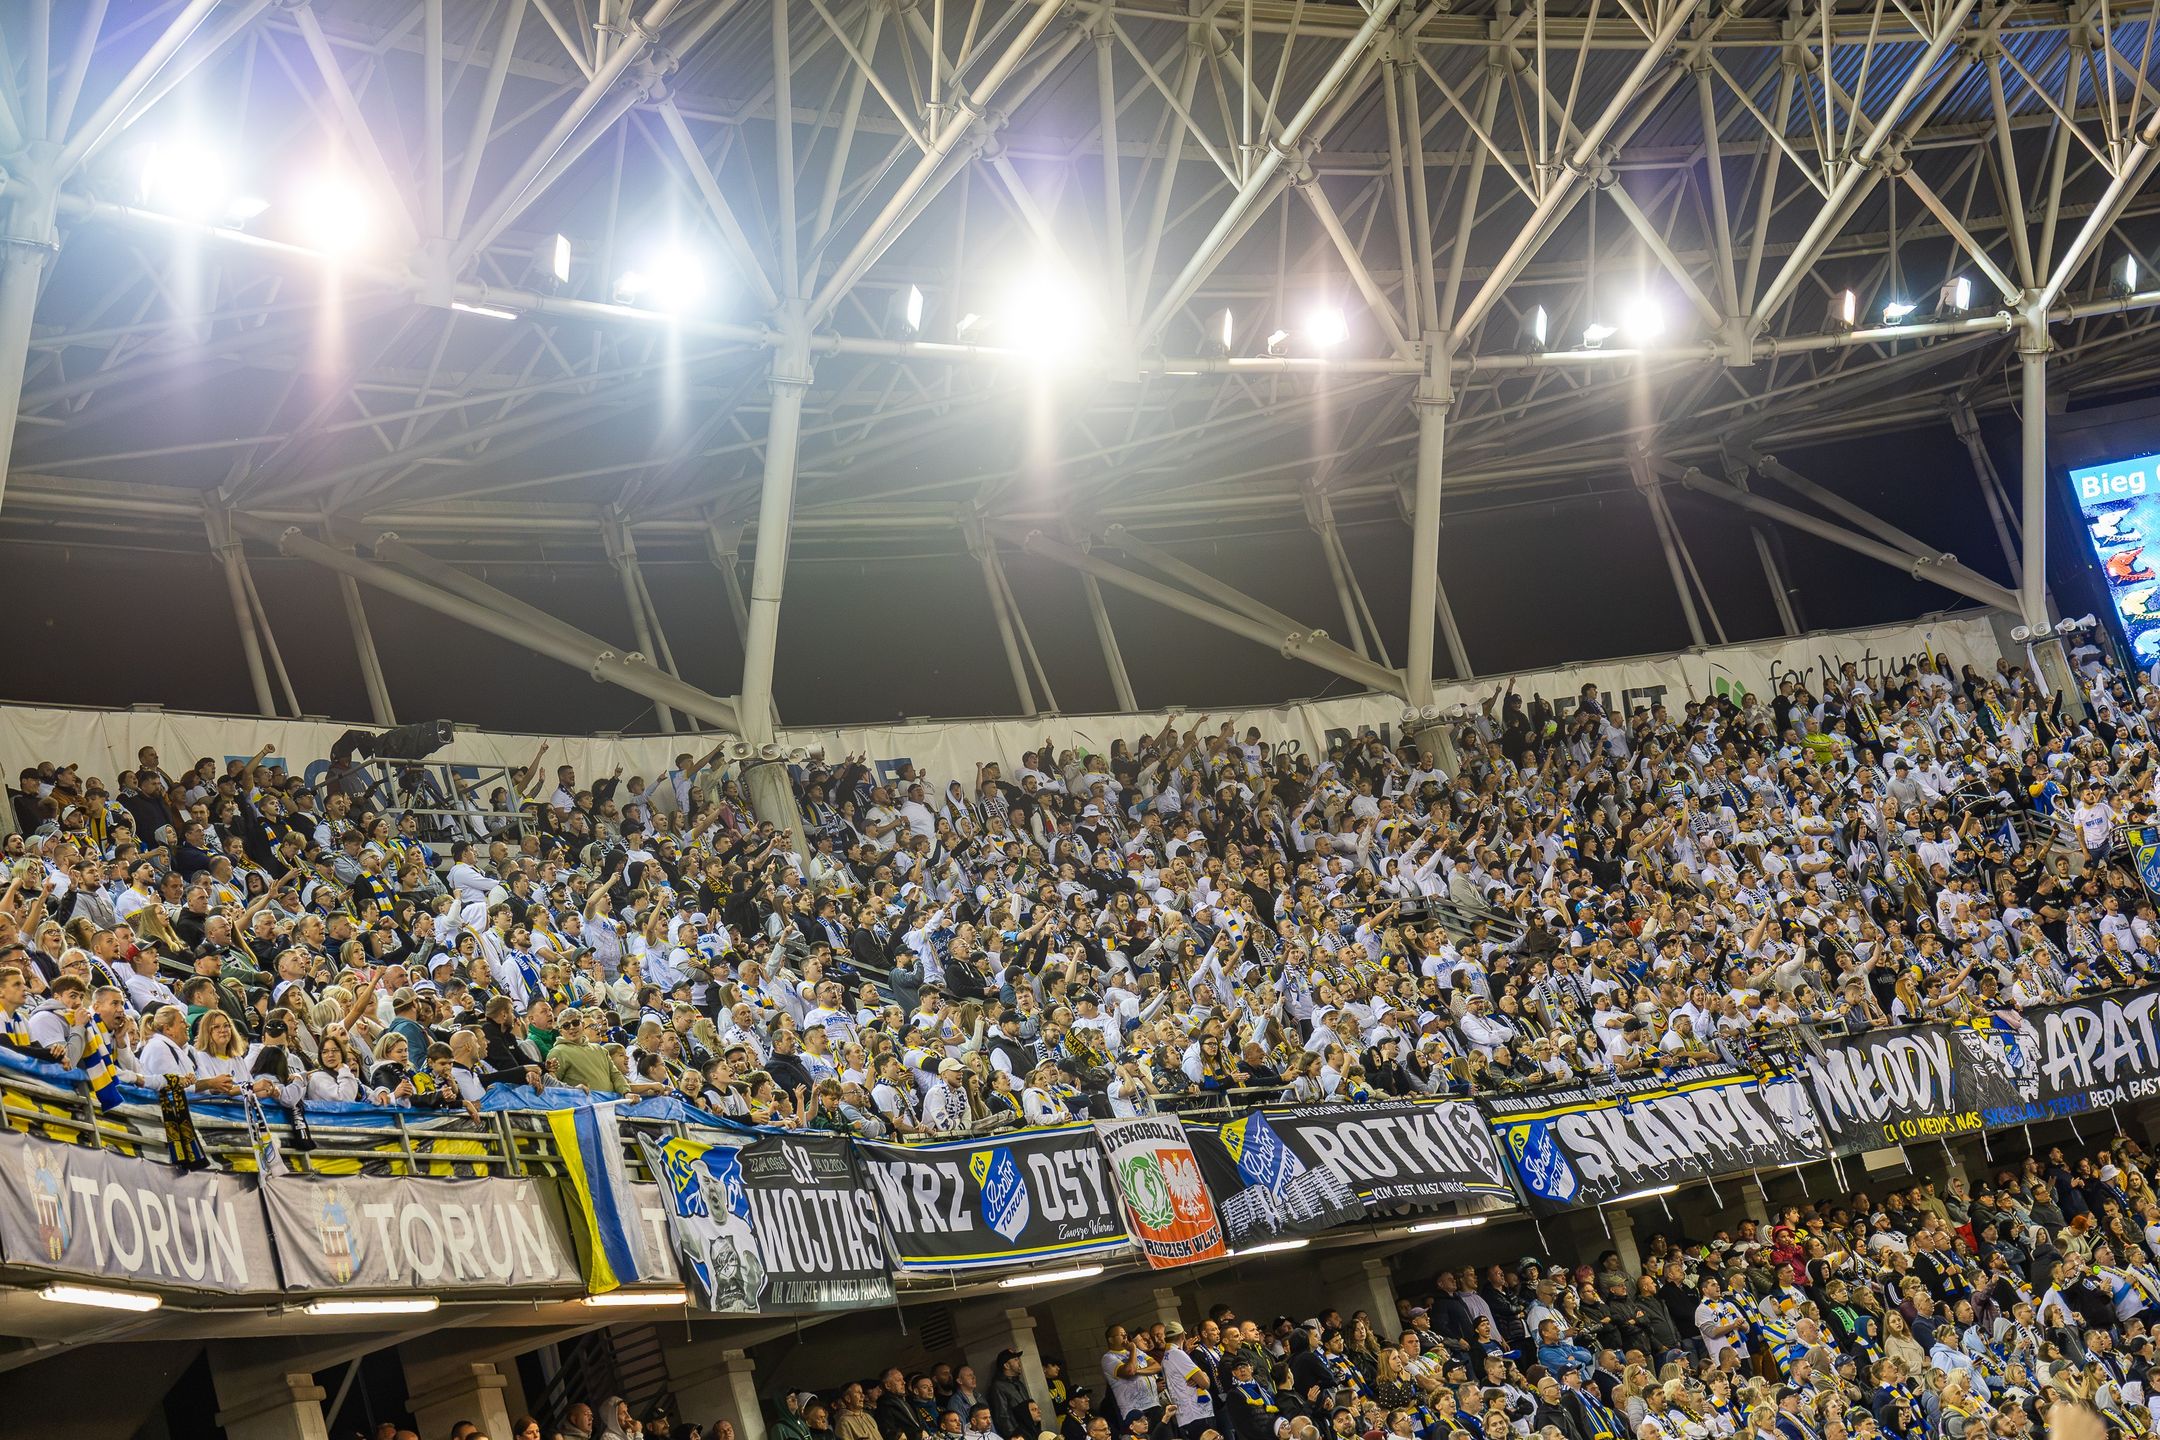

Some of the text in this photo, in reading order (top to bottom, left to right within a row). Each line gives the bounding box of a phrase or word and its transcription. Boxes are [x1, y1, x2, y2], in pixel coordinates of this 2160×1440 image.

[2081, 471, 2146, 499] Bieg
[1804, 992, 2160, 1134] MŁODY APAT
[1290, 1105, 1345, 1118] WPOJONE
[1524, 1096, 1551, 1110] NAS
[1548, 1090, 1586, 1105] SZARE
[1104, 1122, 1186, 1152] DYSKOBOLIA
[1557, 1085, 1779, 1182] SKARPA
[1899, 1120, 1917, 1138] CO
[1955, 1111, 1983, 1131] NAS
[866, 1146, 1111, 1233] WRZ OSY
[986, 1151, 1016, 1222] Apator
[1372, 1178, 1469, 1200] KIM JEST NASZ WRÓG
[70, 1176, 249, 1284] TORUŃ
[363, 1185, 557, 1281] TORUŃ
[745, 1188, 884, 1273] WOJTAS
[1058, 1217, 1115, 1240] Zawsze Wierni
[771, 1281, 783, 1304] NA
[786, 1279, 819, 1303] ZAWSZE
[819, 1280, 829, 1302] W
[831, 1278, 859, 1302] NASZEJ
